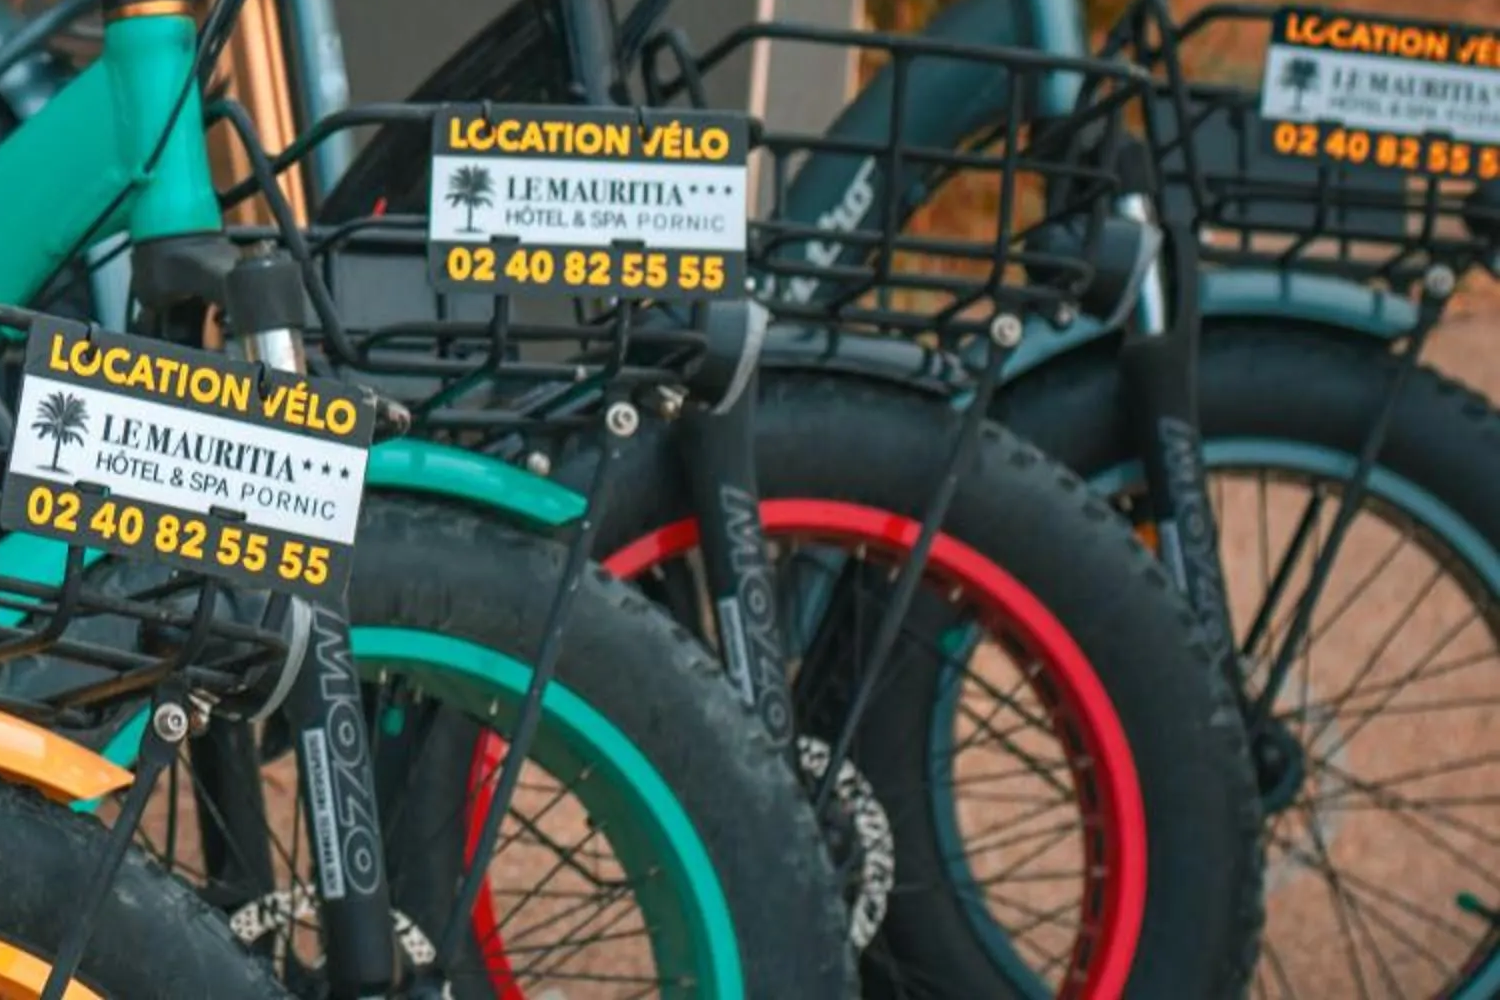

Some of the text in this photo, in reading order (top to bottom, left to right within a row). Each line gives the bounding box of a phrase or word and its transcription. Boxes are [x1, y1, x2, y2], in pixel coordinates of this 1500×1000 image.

[450, 116, 730, 160] LOCATION VÉLO
[1274, 122, 1319, 156] 02
[1324, 128, 1371, 163] 40
[1376, 133, 1421, 169] 82
[1426, 139, 1470, 175] 55
[506, 205, 726, 232] HÔTEL & SPA PORNIC
[507, 175, 685, 206] LE MAURITIA
[447, 246, 725, 291] 02 40 82 55 55
[49, 333, 357, 435] LOCATION VÉLO
[101, 413, 296, 483] LE MAURITIA
[96, 450, 337, 521] HÔTEL & SPA PORNIC
[28, 485, 330, 585] 02 40 82 55 55
[312, 602, 382, 895] MOZO
